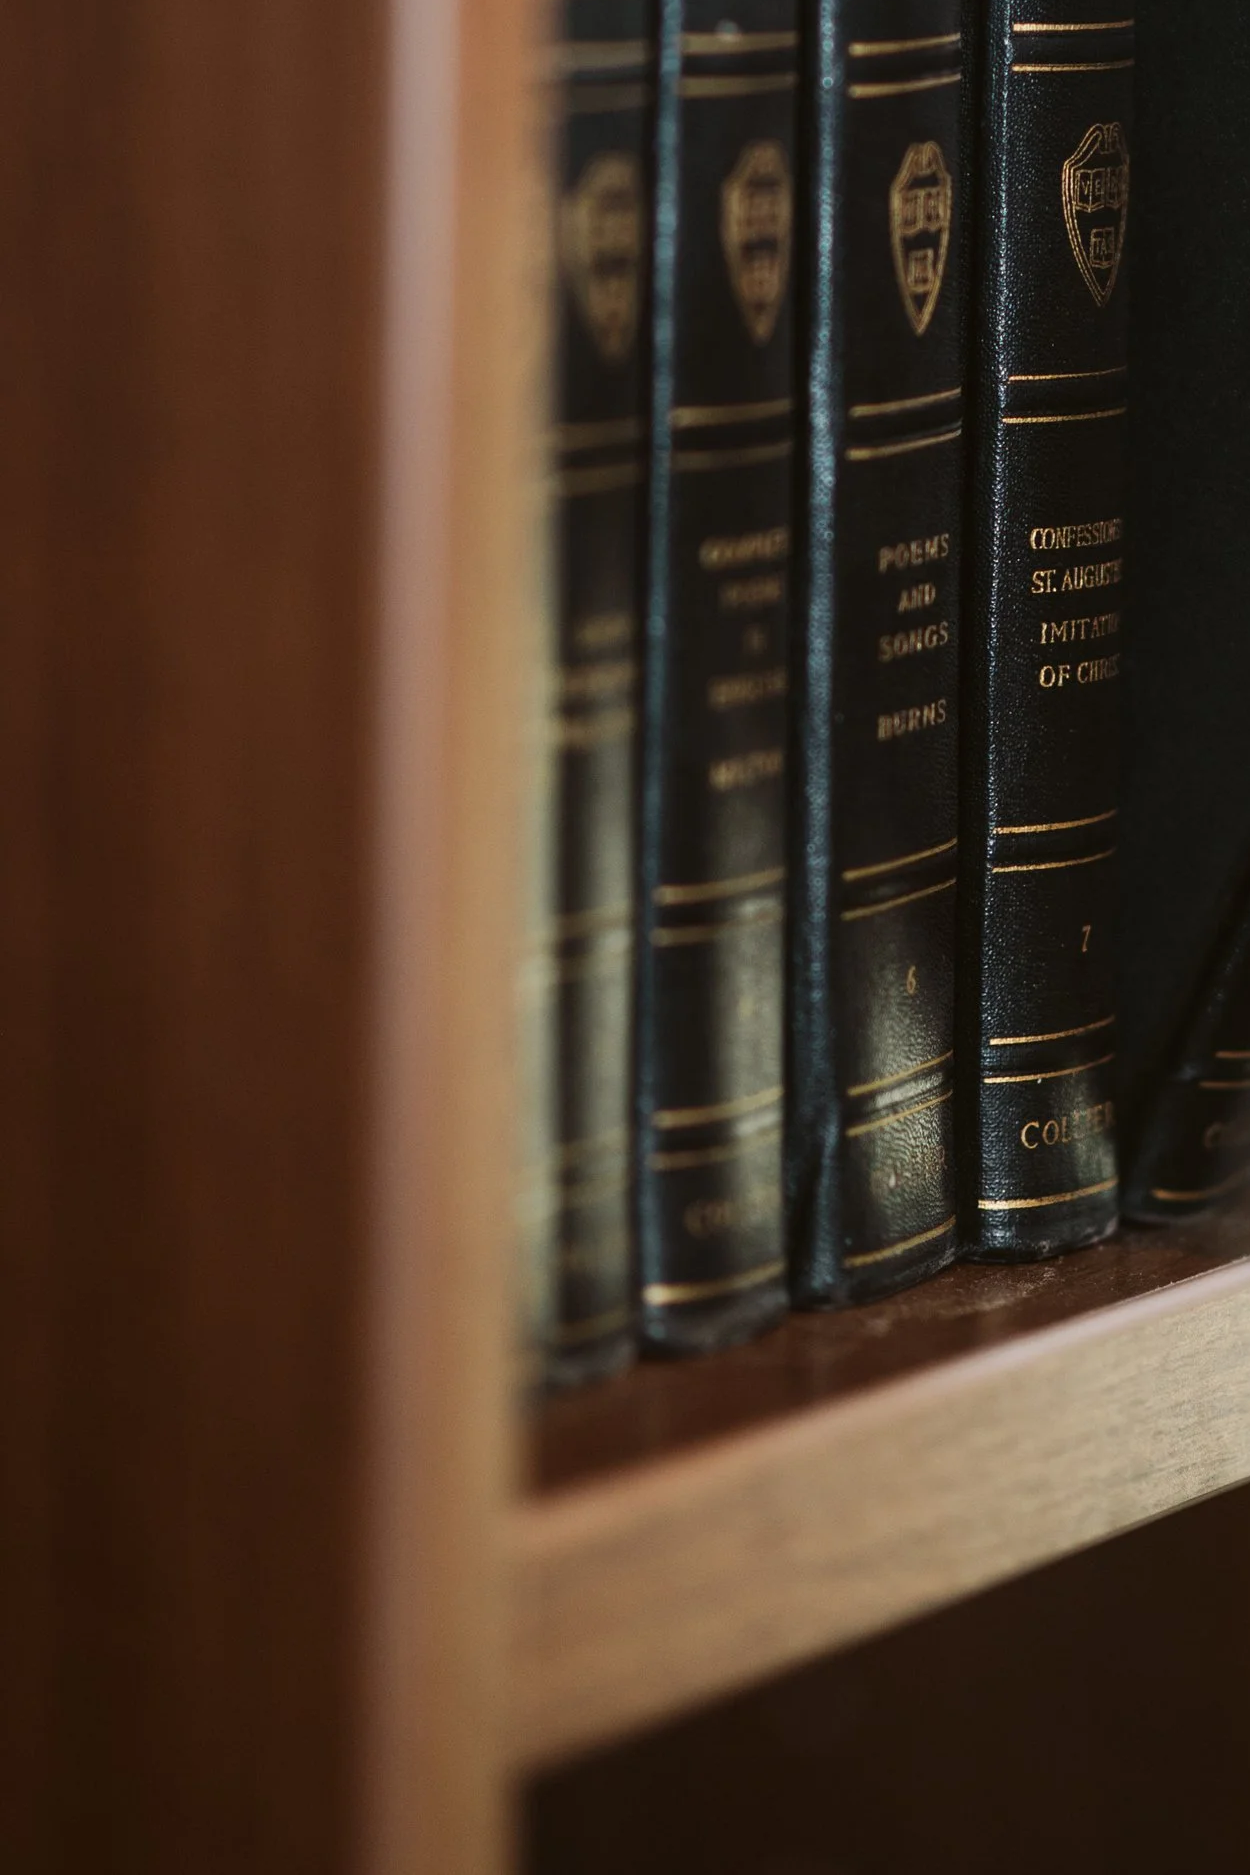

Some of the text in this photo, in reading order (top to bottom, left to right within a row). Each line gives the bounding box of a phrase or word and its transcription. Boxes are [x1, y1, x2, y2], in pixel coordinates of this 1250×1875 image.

[877, 533, 950, 574] POEMS
[1031, 569, 1057, 594] ST.
[898, 582, 936, 613] AND
[877, 621, 949, 663] SONGS
[1040, 611, 1121, 644] IMITATIO
[1039, 665, 1071, 688] OF
[877, 699, 947, 742] BURNS
[1081, 924, 1092, 953] 7
[906, 965, 917, 995] 6
